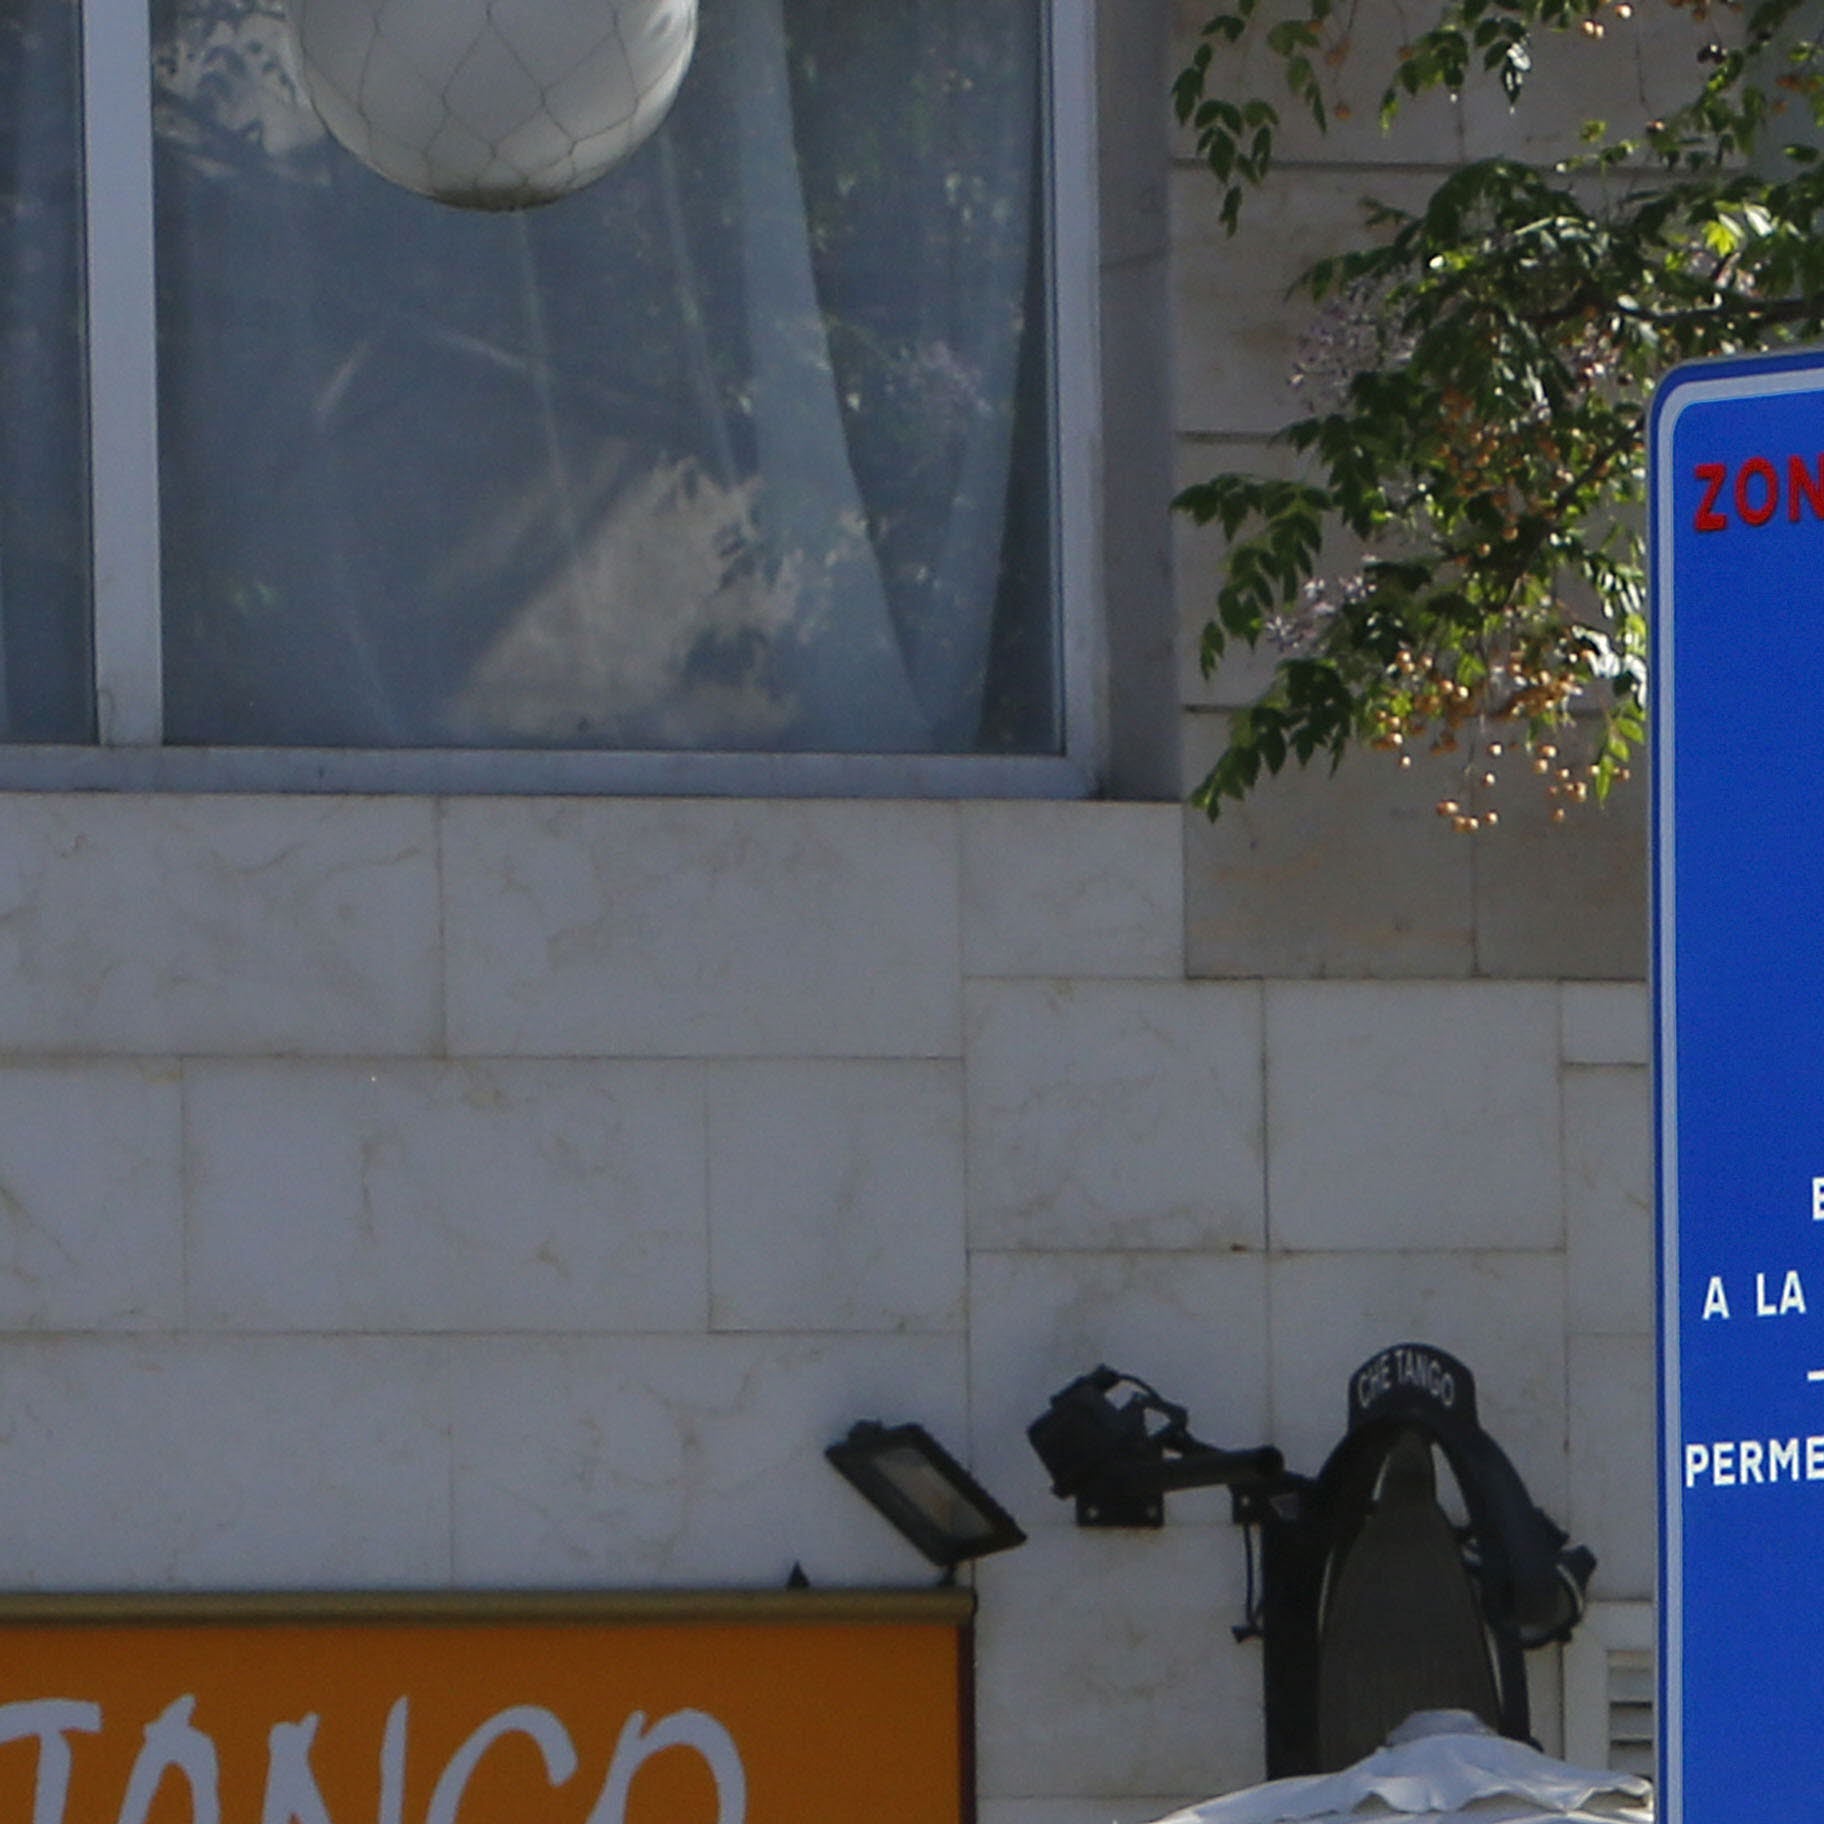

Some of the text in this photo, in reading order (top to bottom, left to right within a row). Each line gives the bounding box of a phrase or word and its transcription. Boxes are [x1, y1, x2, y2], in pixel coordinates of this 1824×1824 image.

[1702, 1276, 1730, 1320] A
[1755, 1270, 1806, 1316] LA
[1359, 1348, 1455, 1408] CHE TANGO
